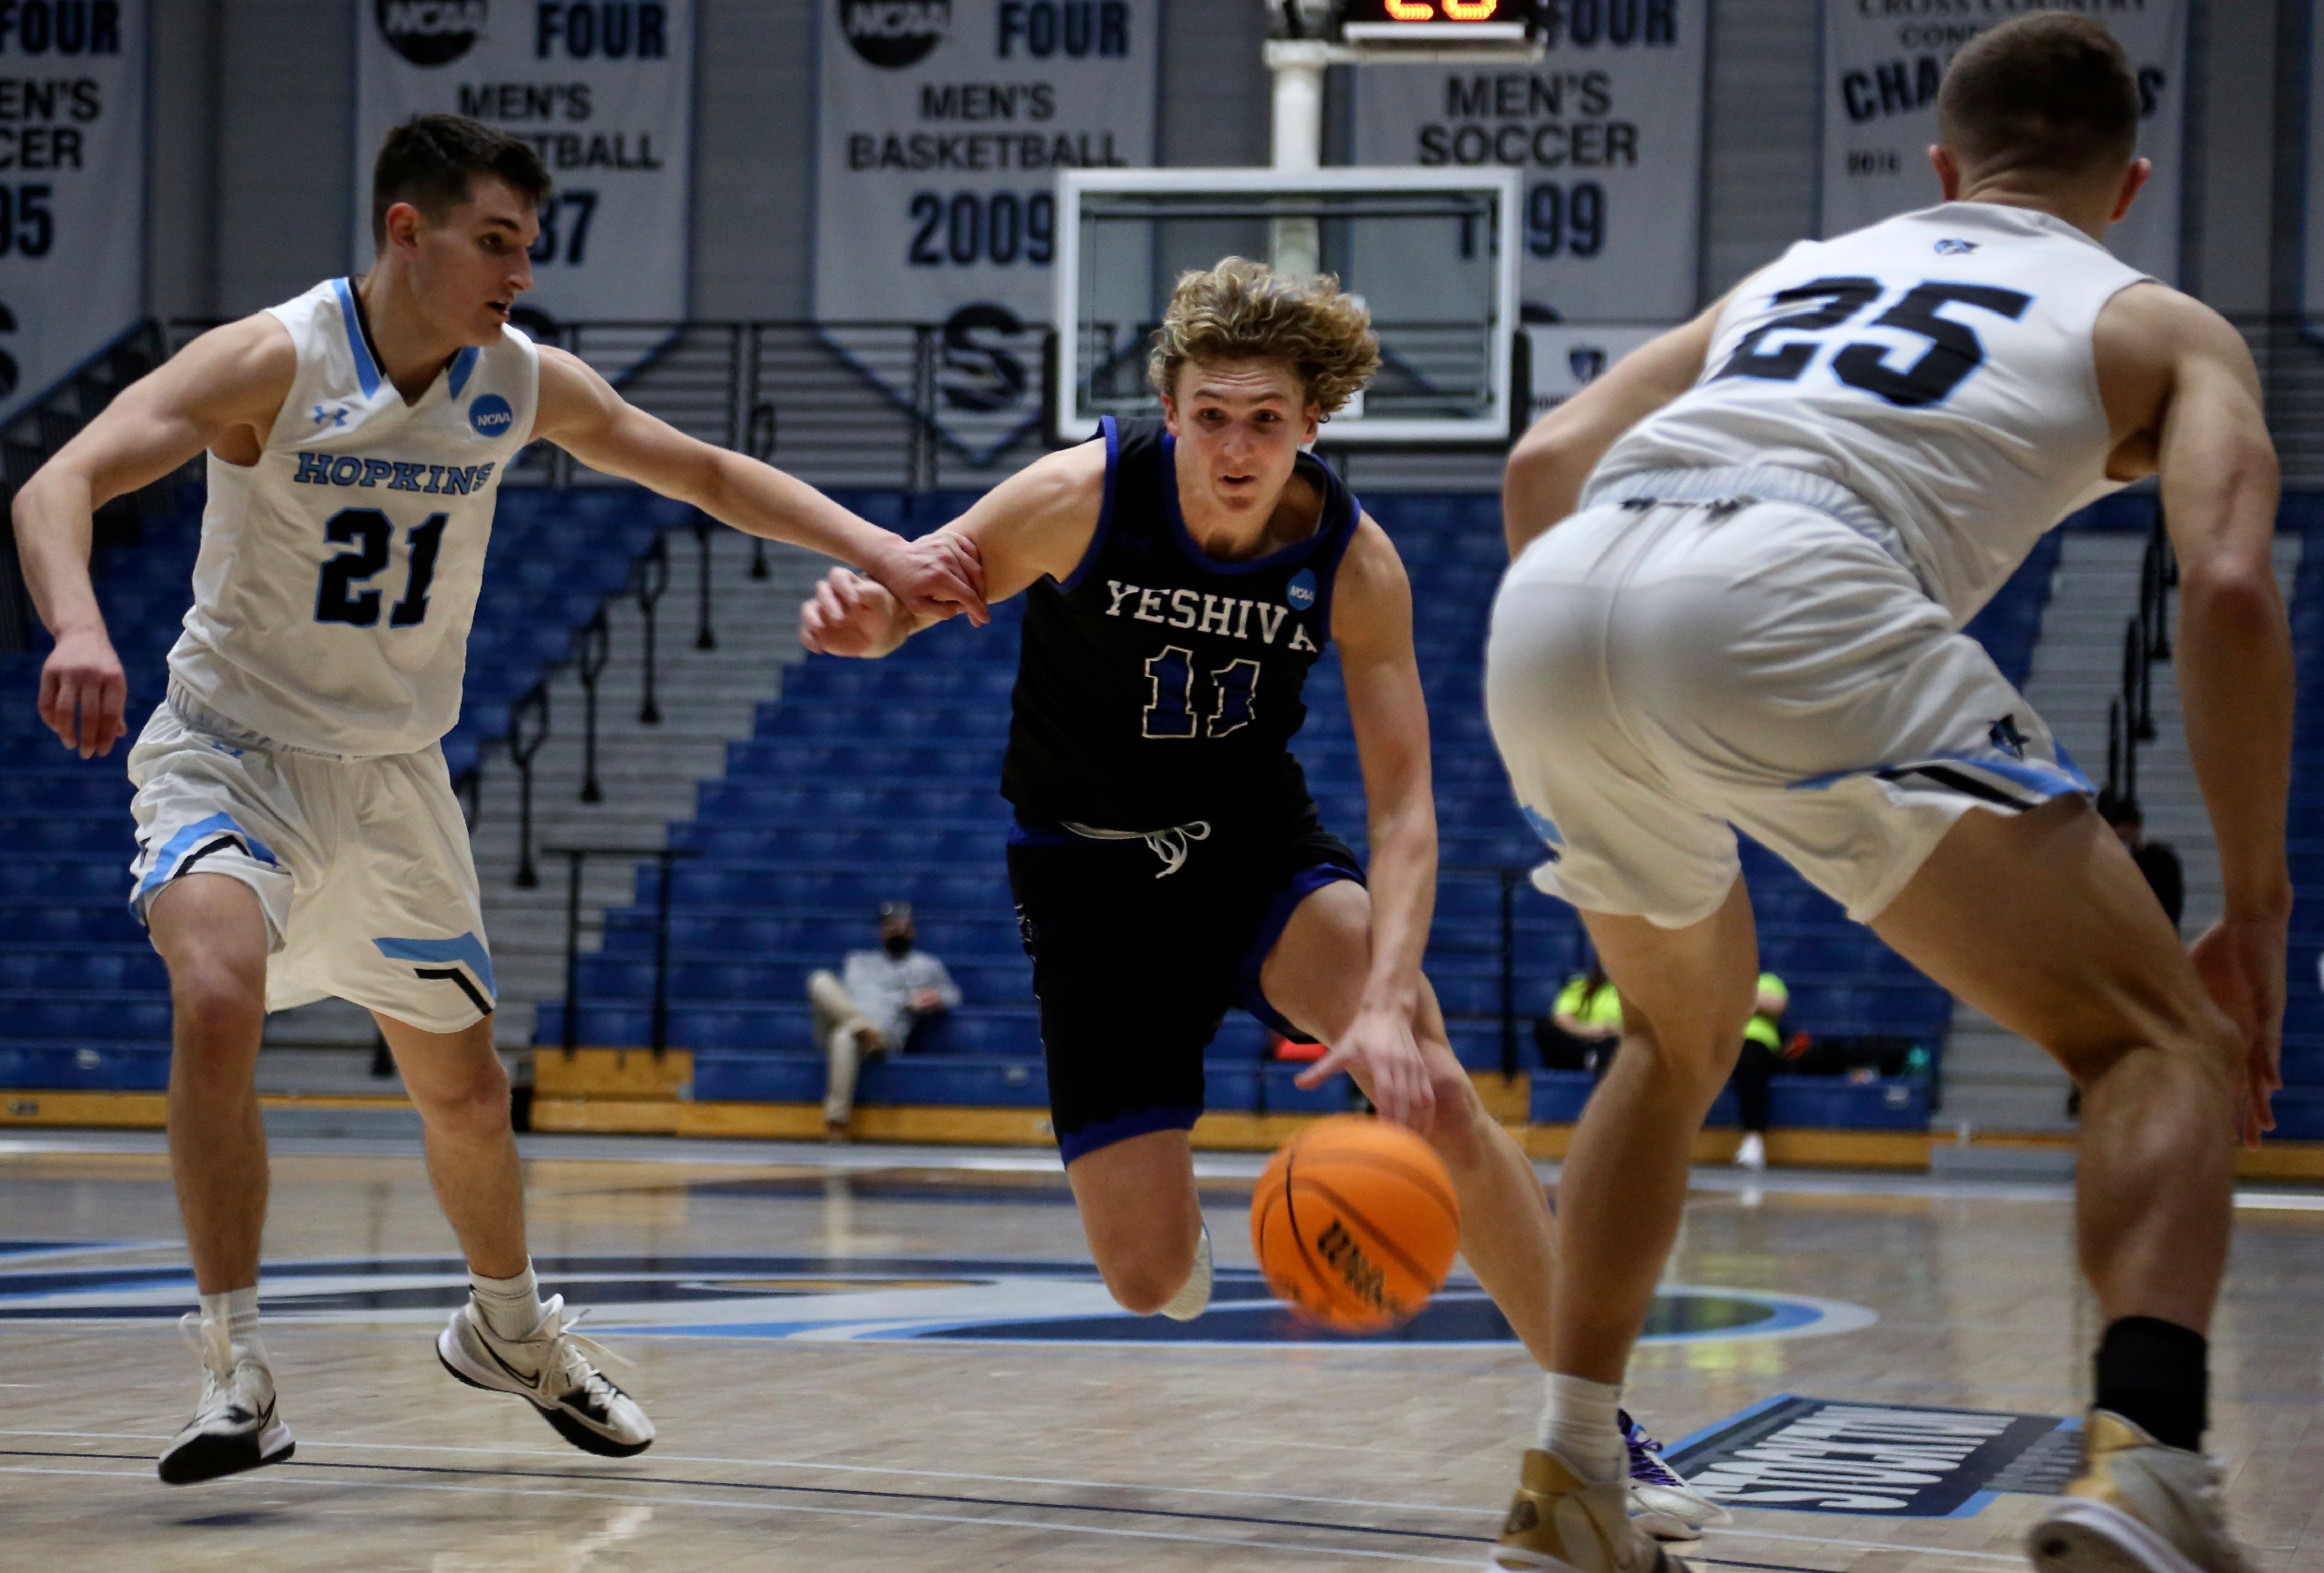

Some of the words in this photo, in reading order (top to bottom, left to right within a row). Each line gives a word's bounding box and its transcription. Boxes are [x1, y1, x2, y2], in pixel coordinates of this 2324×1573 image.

[537, 1, 667, 58] FOUR
[997, 2, 1128, 58] FOUR
[461, 83, 592, 120] MEN'S
[922, 83, 1055, 120] MEN'S
[1447, 73, 1612, 118] MEN'S
[847, 131, 1127, 170] BASKETBALL
[1418, 123, 1639, 167] SOCCER
[908, 188, 1055, 266] 2009
[1703, 275, 2038, 409] 25
[477, 414, 511, 426] NCAA
[313, 506, 450, 629] 21
[1105, 579, 1318, 653] YESHIVA
[1290, 585, 1315, 601] NCAA
[1141, 644, 1262, 740] 11
